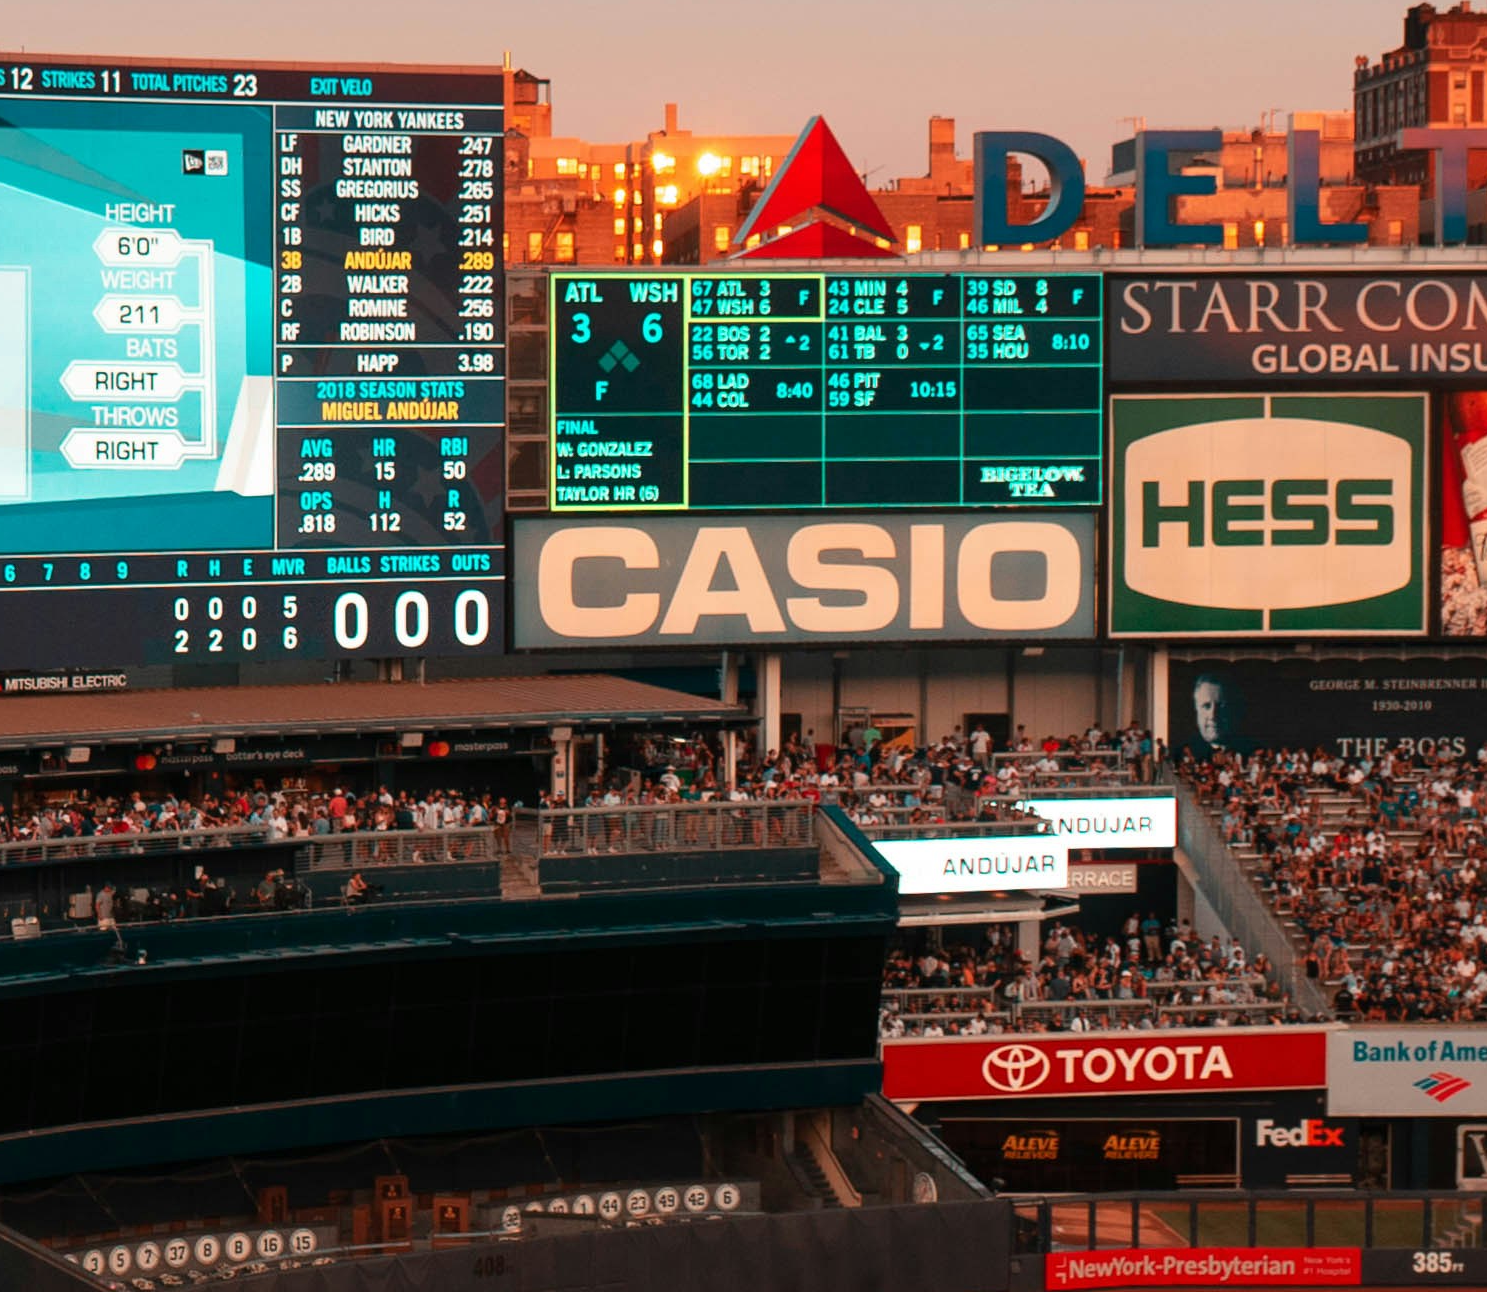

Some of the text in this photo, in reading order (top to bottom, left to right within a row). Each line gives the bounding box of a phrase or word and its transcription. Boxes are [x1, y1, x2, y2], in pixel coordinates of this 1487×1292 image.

[10, 67, 33, 91] 12
[41, 71, 95, 89] STRIKES
[100, 70, 121, 92] 11
[316, 110, 464, 130] NEW YORK YANKEES
[343, 136, 412, 154] GARDNER
[343, 159, 412, 176] STANTON
[336, 180, 418, 198] GREGORIUS
[105, 203, 175, 223] HEIGHT
[101, 270, 177, 289] WEIGHT
[565, 283, 678, 303] ATL WSH
[120, 305, 159, 324] 211
[1120, 282, 1342, 334] STARR
[127, 339, 178, 357] BATS
[1252, 343, 1398, 374] GLOBAL
[95, 372, 158, 391] RIGHT
[91, 406, 178, 426] THROWS
[96, 441, 158, 460] RIGHT
[1142, 478, 1396, 549] HESS
[538, 522, 1081, 637] CASIO
[5, 673, 126, 691] MITSUBISHI ELECTRIC
[1309, 679, 1360, 691] GEORGE
[1364, 679, 1379, 690] M.
[1383, 679, 1478, 690] STEINBRENNER
[1372, 700, 1432, 712] 1930-2010
[1336, 737, 1386, 758] THE
[1351, 1041, 1411, 1063] Bank
[1413, 1041, 1438, 1063] of
[1057, 1045, 1233, 1084] TOYOTA
[1001, 1134, 1060, 1152] ALEVE
[1103, 1134, 1161, 1152] ALEVE
[1256, 1119, 1345, 1148] FedEx
[1069, 1253, 1296, 1281] NewYork-Presbyterian
